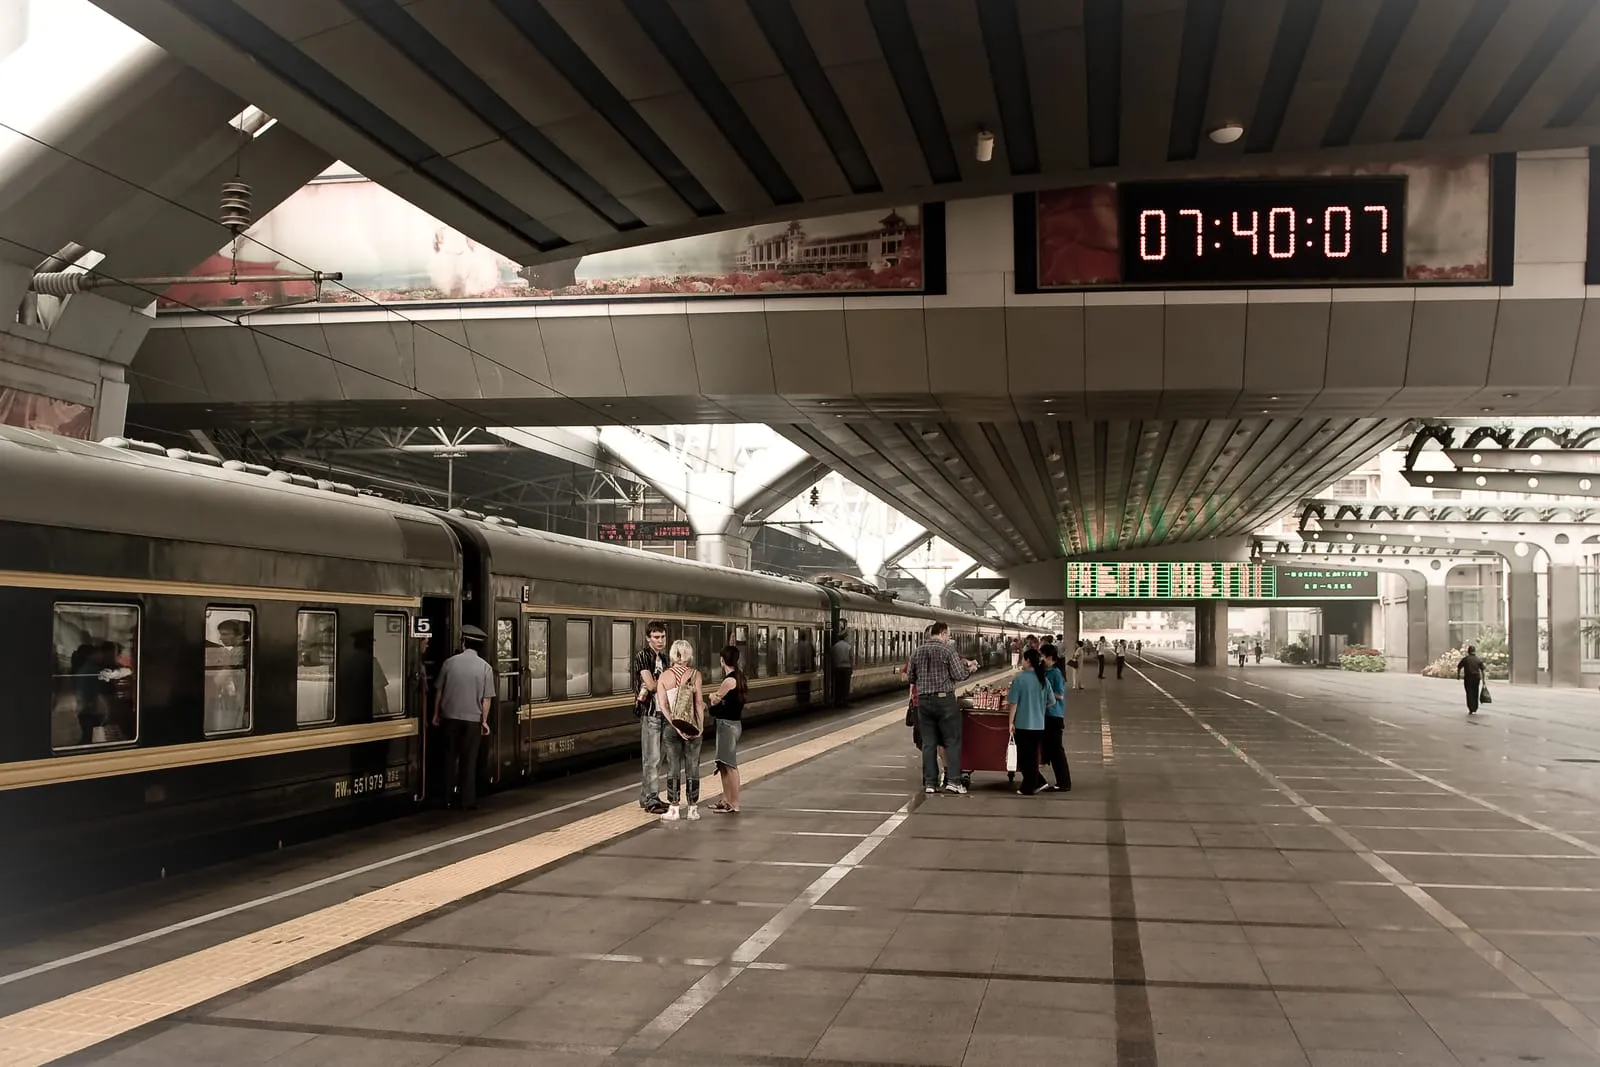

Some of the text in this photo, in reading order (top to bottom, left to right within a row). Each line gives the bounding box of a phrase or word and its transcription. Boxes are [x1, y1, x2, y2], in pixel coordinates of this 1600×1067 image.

[1140, 206, 1388, 260] 07:40:07
[417, 618, 430, 632] 5
[353, 773, 384, 794] 551979
